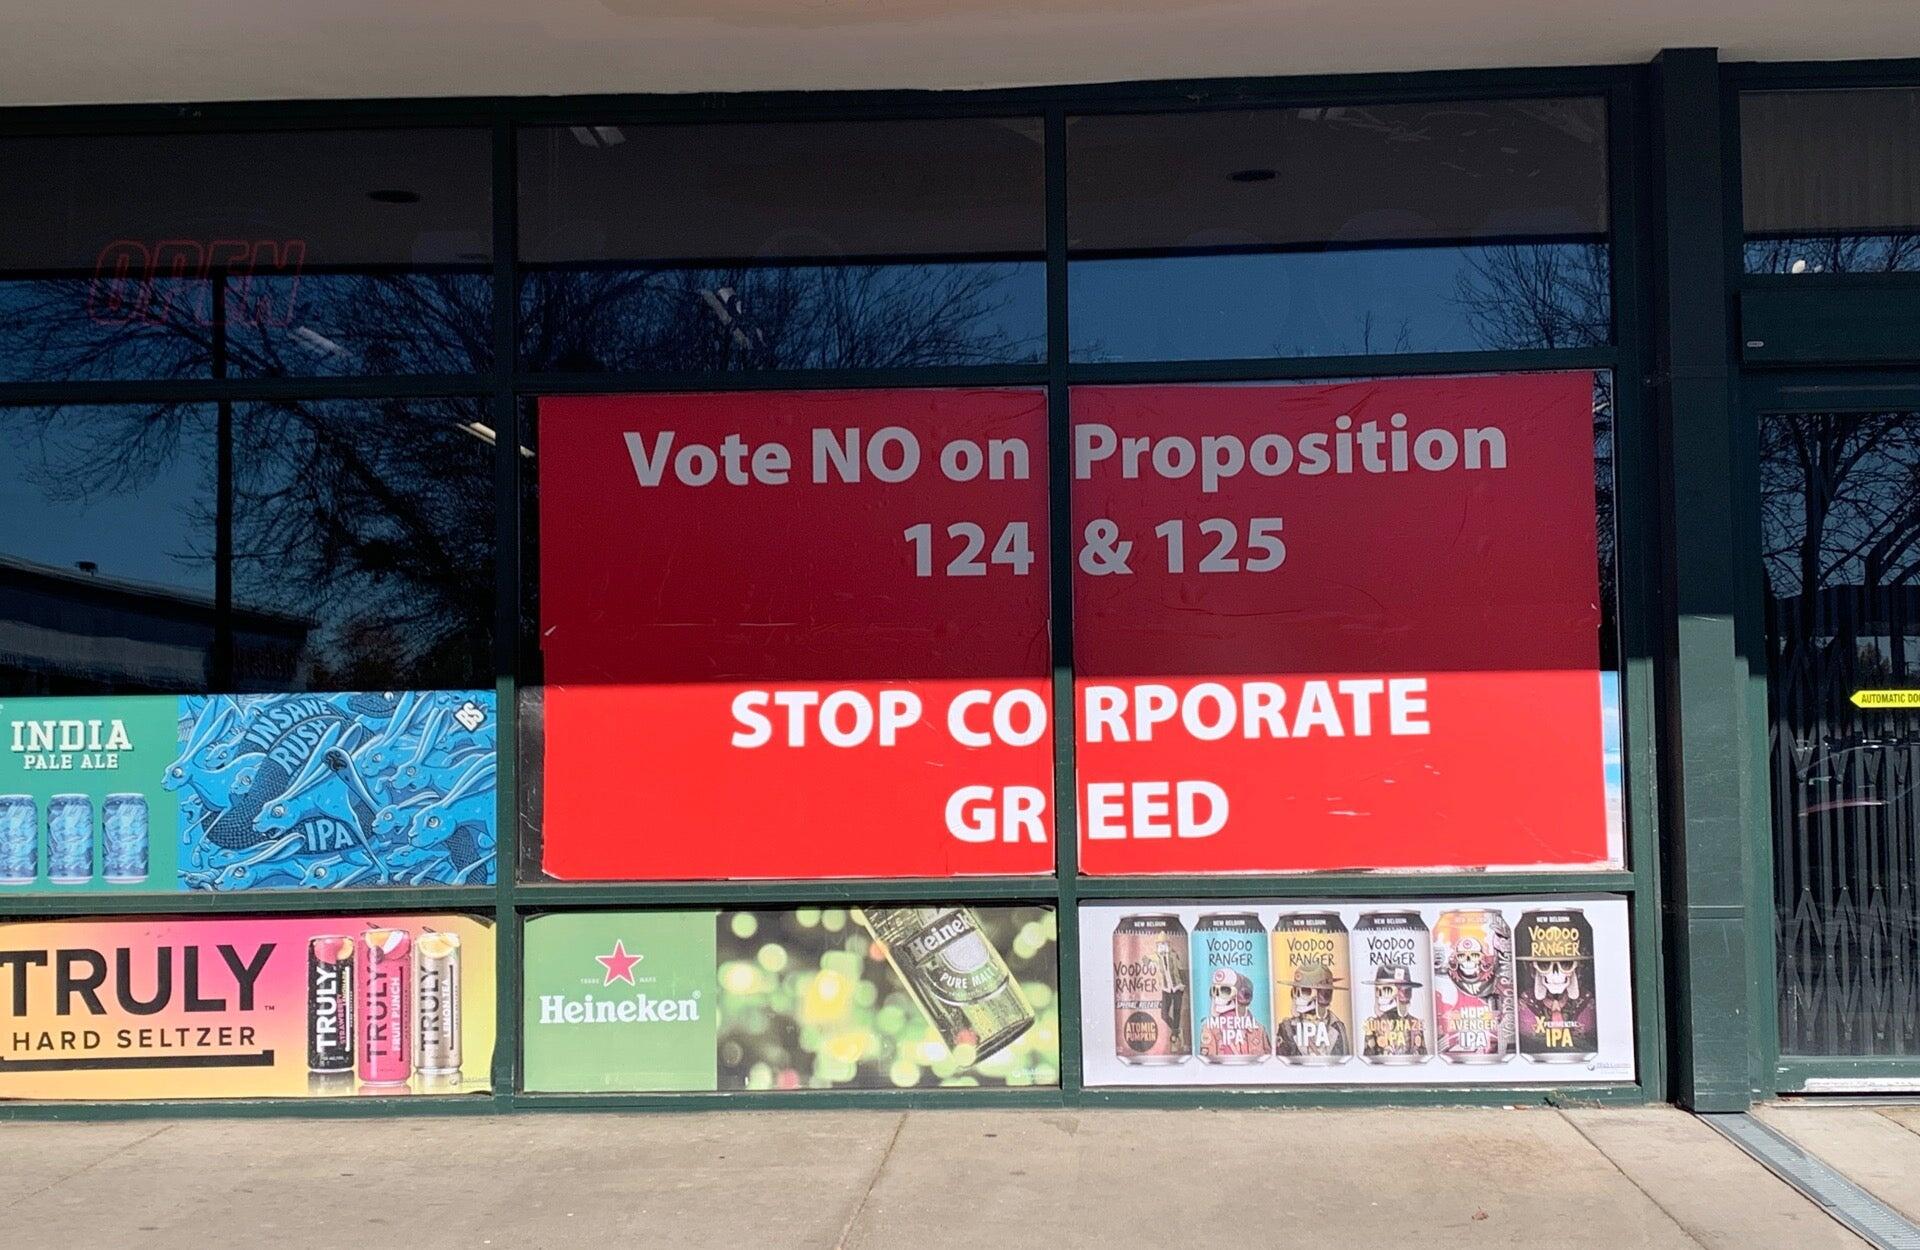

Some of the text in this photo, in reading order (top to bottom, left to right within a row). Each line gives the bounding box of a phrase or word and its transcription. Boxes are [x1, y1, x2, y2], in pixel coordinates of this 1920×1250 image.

[88, 238, 306, 327] OPEN
[623, 413, 1507, 493] Vote NO on Proposition
[904, 517, 1287, 577] 124 & 125
[1861, 693, 1920, 704] AUTOMATIC DO
[247, 699, 331, 750] INSANE
[731, 690, 922, 748] STOP
[11, 719, 134, 752] INDIA
[269, 719, 328, 775] RUSH
[23, 753, 119, 770] PALE ALE
[305, 819, 354, 851] IPA
[1528, 926, 1579, 941] VOODOO
[1207, 938, 1252, 951] VOODOO
[1287, 938, 1334, 951] VOODOO
[1367, 937, 1415, 950] VOODOO
[1531, 941, 1580, 956] RANGER
[1209, 953, 1254, 966] RANGER
[1289, 952, 1335, 966] RANGER
[1369, 952, 1416, 966] RANGER
[1113, 961, 1157, 977] VOODOO
[0, 943, 277, 1017] TRULY
[940, 972, 968, 989] PURE
[1115, 977, 1158, 994] RANGER
[316, 966, 337, 1053] TRULY
[366, 967, 387, 1063] TRULY
[391, 976, 401, 1051] FRUIT PUNCH
[420, 965, 440, 1051] TRULY
[442, 979, 451, 1037] LEMON TEA
[539, 993, 699, 1024] Heineken
[1460, 1007, 1484, 1020] HOP
[1126, 1022, 1155, 1032] ATOMIC
[1207, 1017, 1258, 1030] IMPERIAL
[1448, 1019, 1497, 1031] AVENGER
[13, 1027, 256, 1051] HARD SELTZER
[1126, 1032, 1156, 1042] PUMPKIN
[1222, 1030, 1244, 1045] IPA
[1294, 1022, 1330, 1047] IPA
[1460, 1031, 1487, 1048] IPA
[1546, 1028, 1573, 1047] IPA
